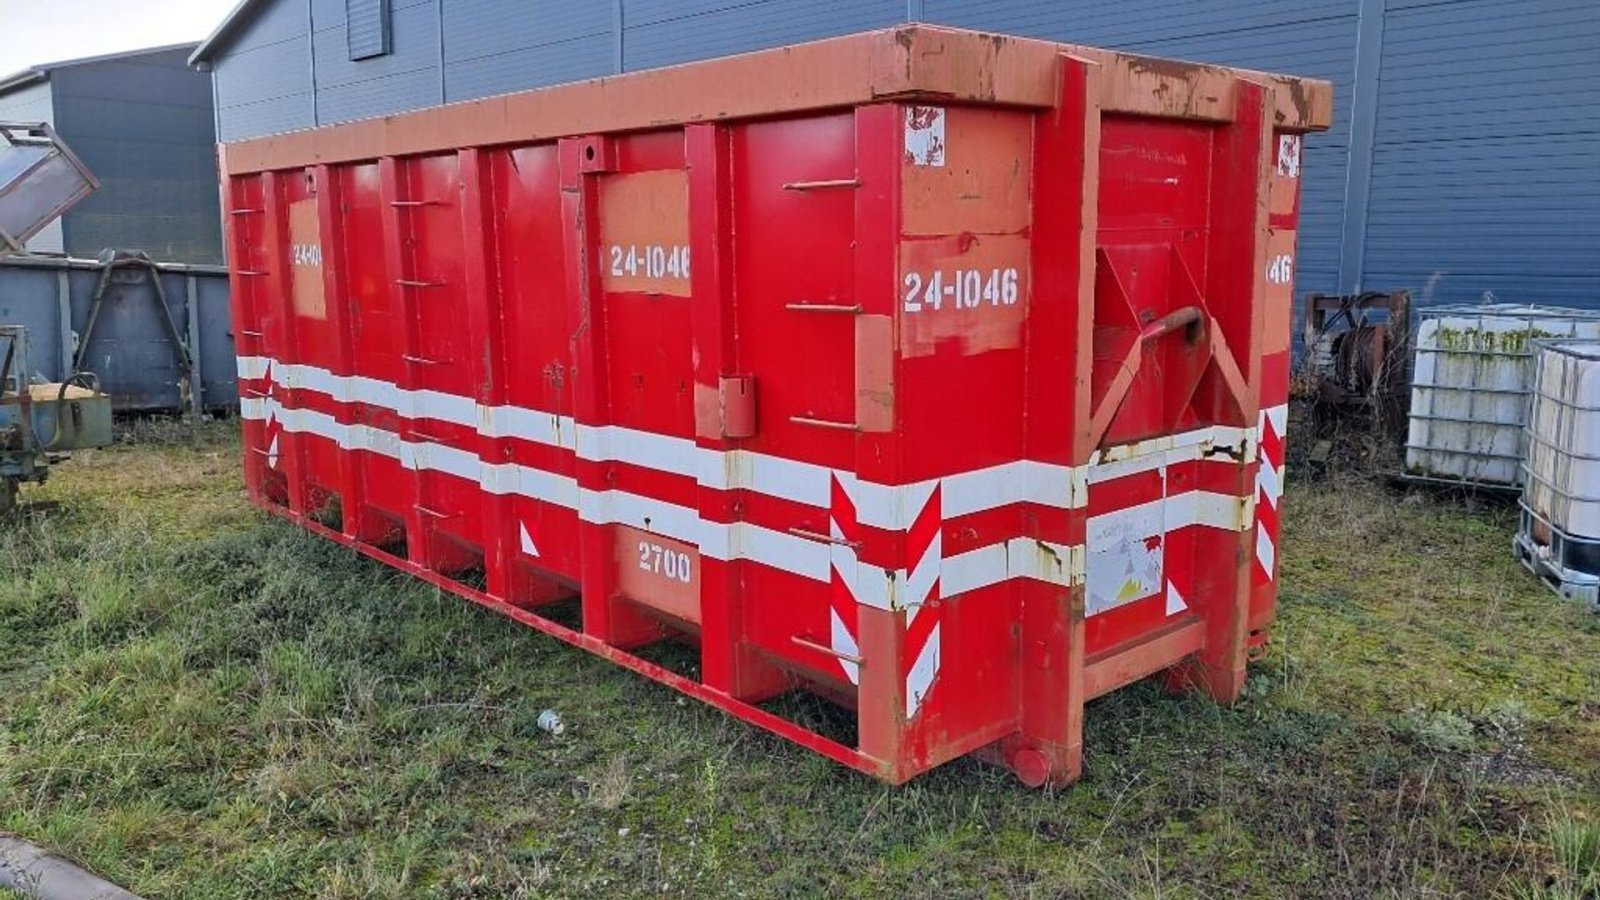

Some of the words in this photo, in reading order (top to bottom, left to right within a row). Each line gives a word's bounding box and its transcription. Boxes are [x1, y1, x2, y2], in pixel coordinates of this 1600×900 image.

[294, 244, 321, 267] 24-10
[1265, 254, 1291, 284] 46
[905, 267, 1018, 312] 24-1046
[639, 541, 690, 583] 2700
